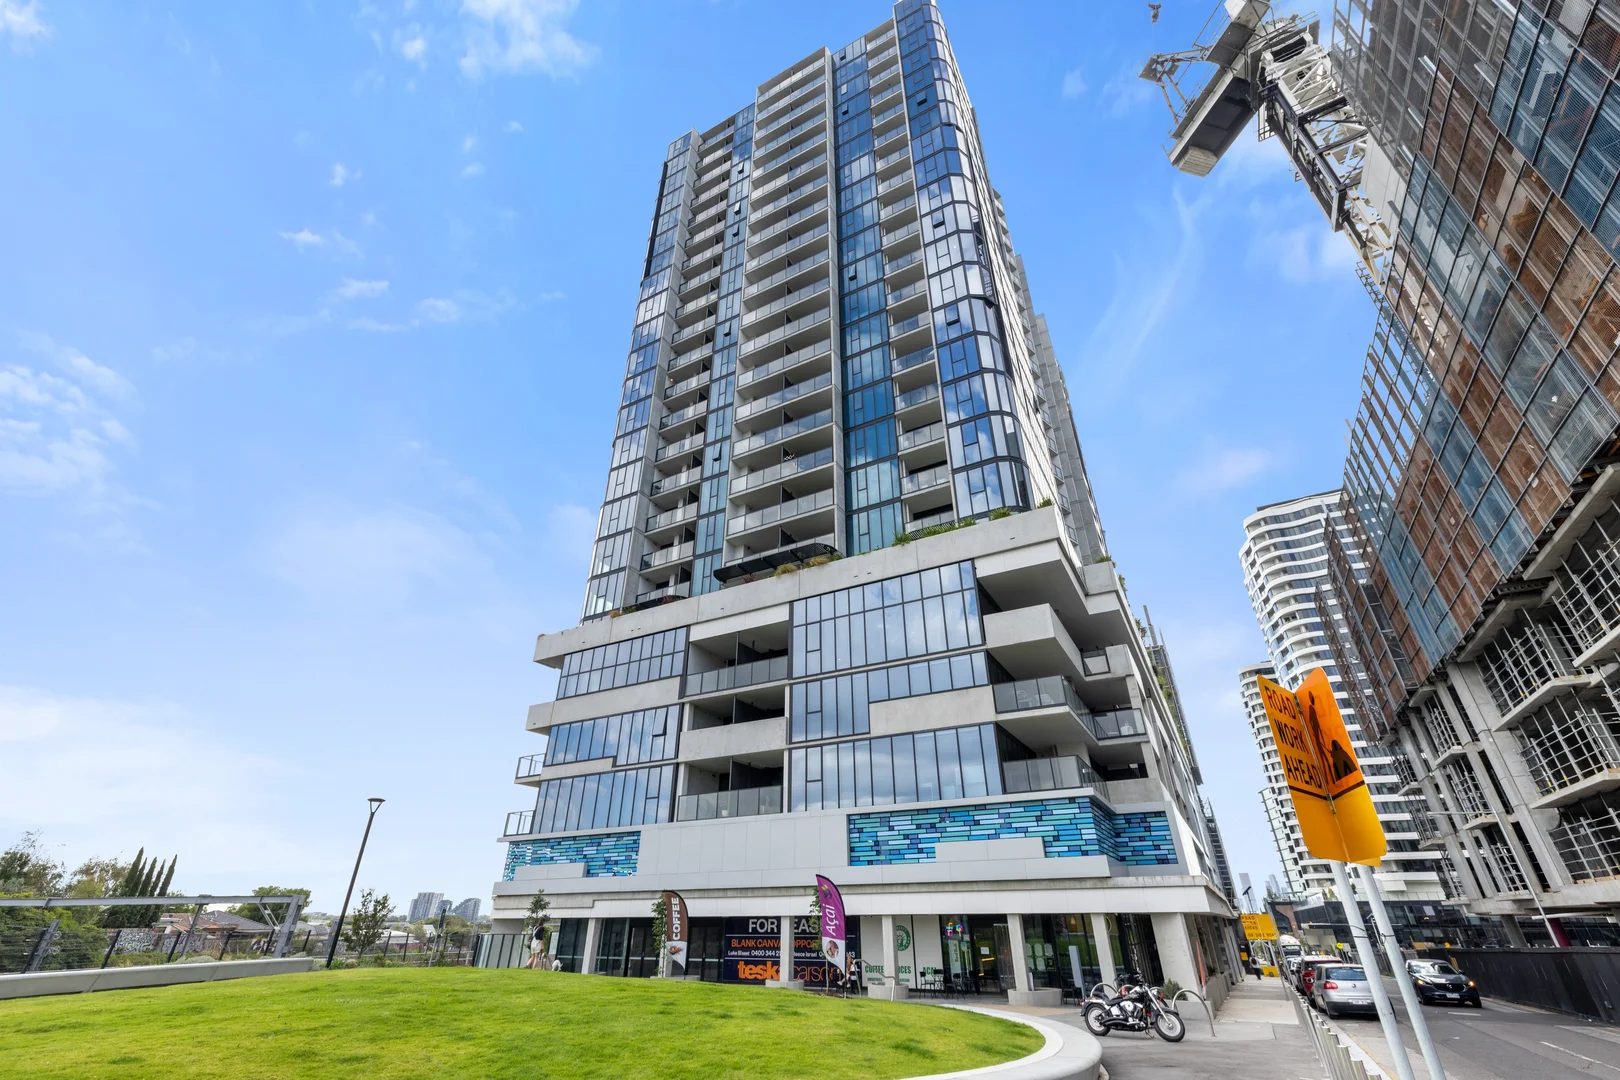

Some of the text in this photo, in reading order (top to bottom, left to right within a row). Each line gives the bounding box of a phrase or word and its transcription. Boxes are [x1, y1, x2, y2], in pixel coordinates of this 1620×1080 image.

[1264, 685, 1297, 720] ROAD
[1274, 718, 1309, 755] WORK
[1284, 754, 1322, 789] AHEAD
[671, 897, 681, 940] COFFEE
[748, 918, 778, 933] FOR
[822, 903, 839, 936] Açai
[731, 939, 781, 948] BLANK CANV
